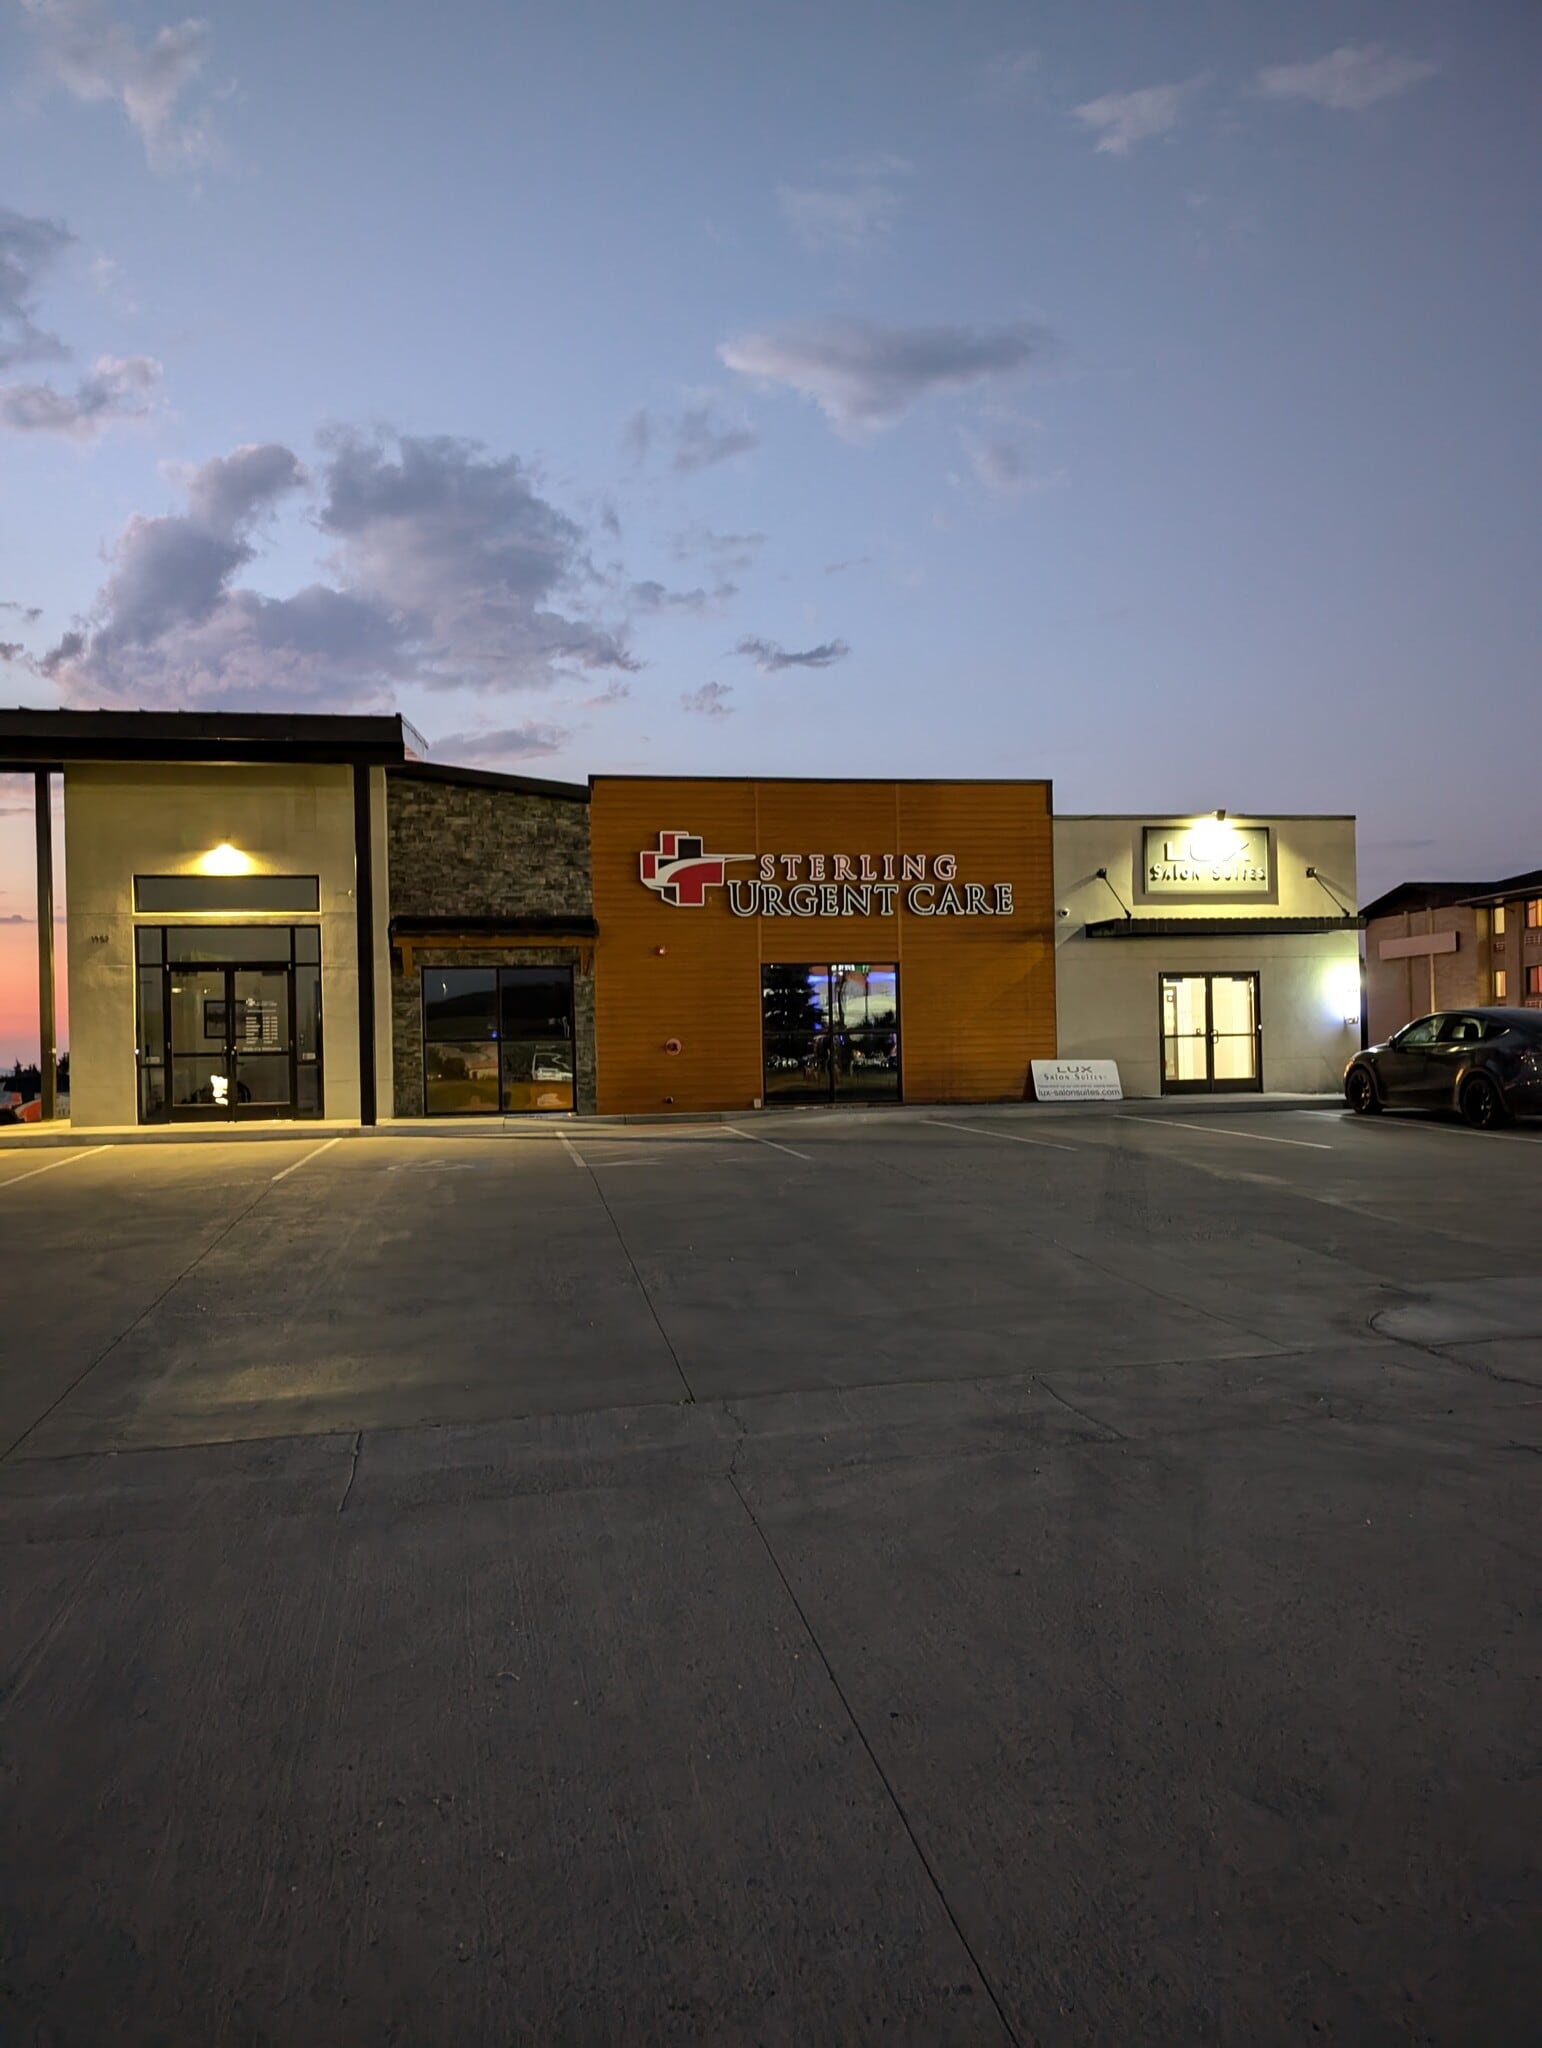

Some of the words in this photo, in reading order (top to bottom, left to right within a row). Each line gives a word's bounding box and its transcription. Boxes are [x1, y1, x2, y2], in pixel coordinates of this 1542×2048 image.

[760, 854, 958, 881] STERLING
[728, 879, 899, 917] URGENT
[907, 883, 1014, 916] CARE
